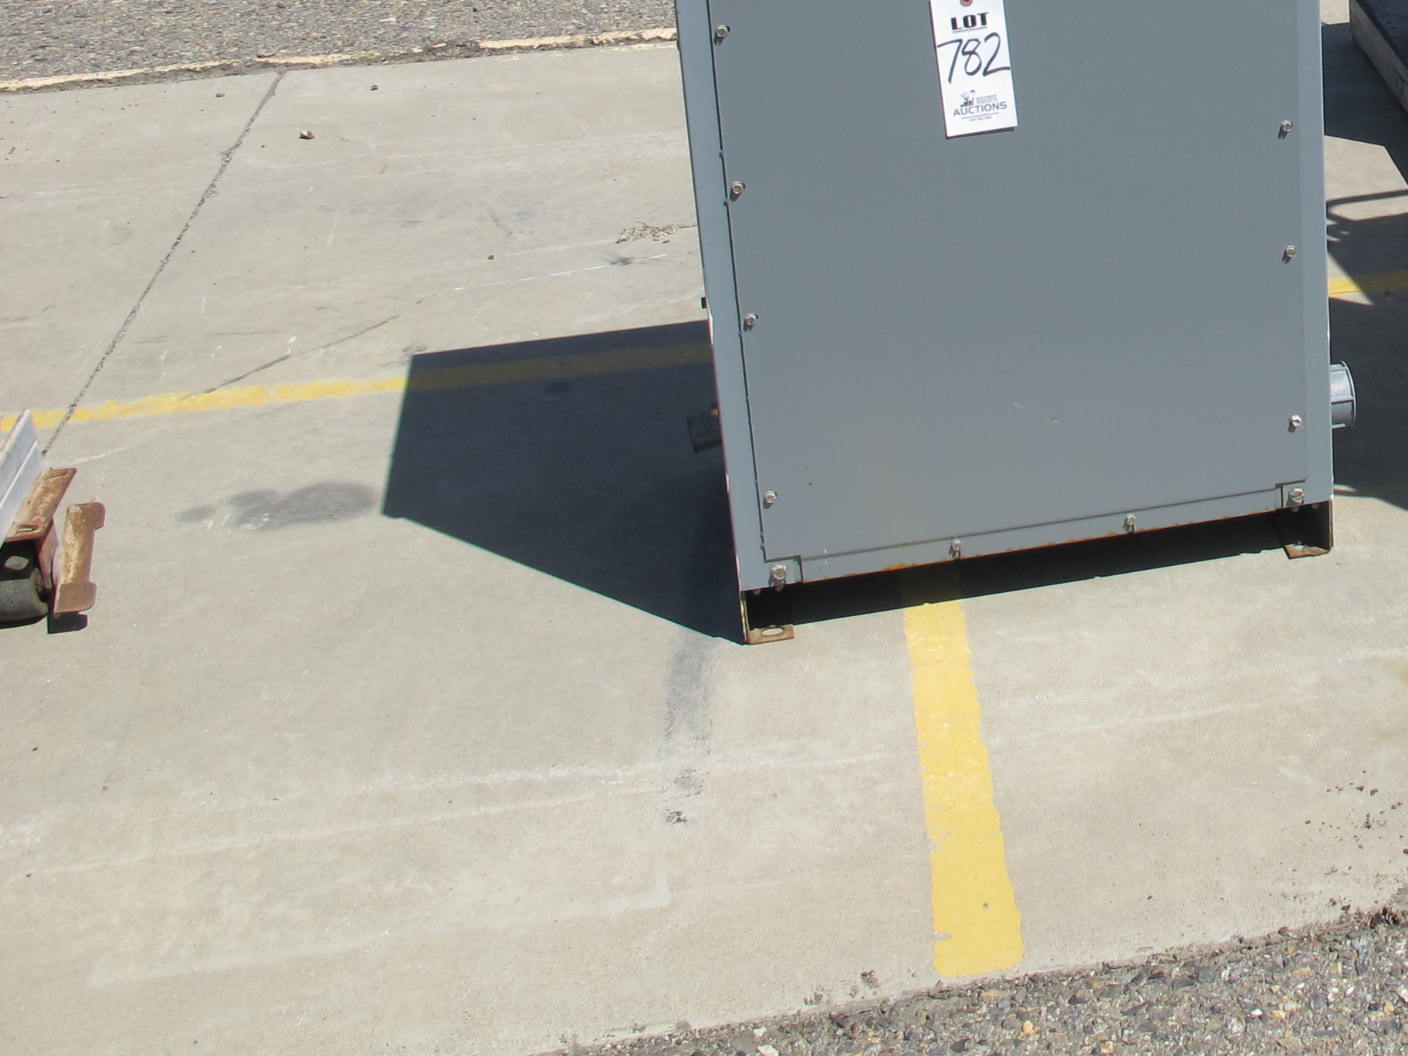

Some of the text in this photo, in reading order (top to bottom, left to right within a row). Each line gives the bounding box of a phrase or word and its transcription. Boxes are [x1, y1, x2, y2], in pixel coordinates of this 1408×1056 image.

[951, 12, 989, 30] LOT
[937, 32, 1011, 84] 782
[953, 101, 1007, 116] AUCTIONS
